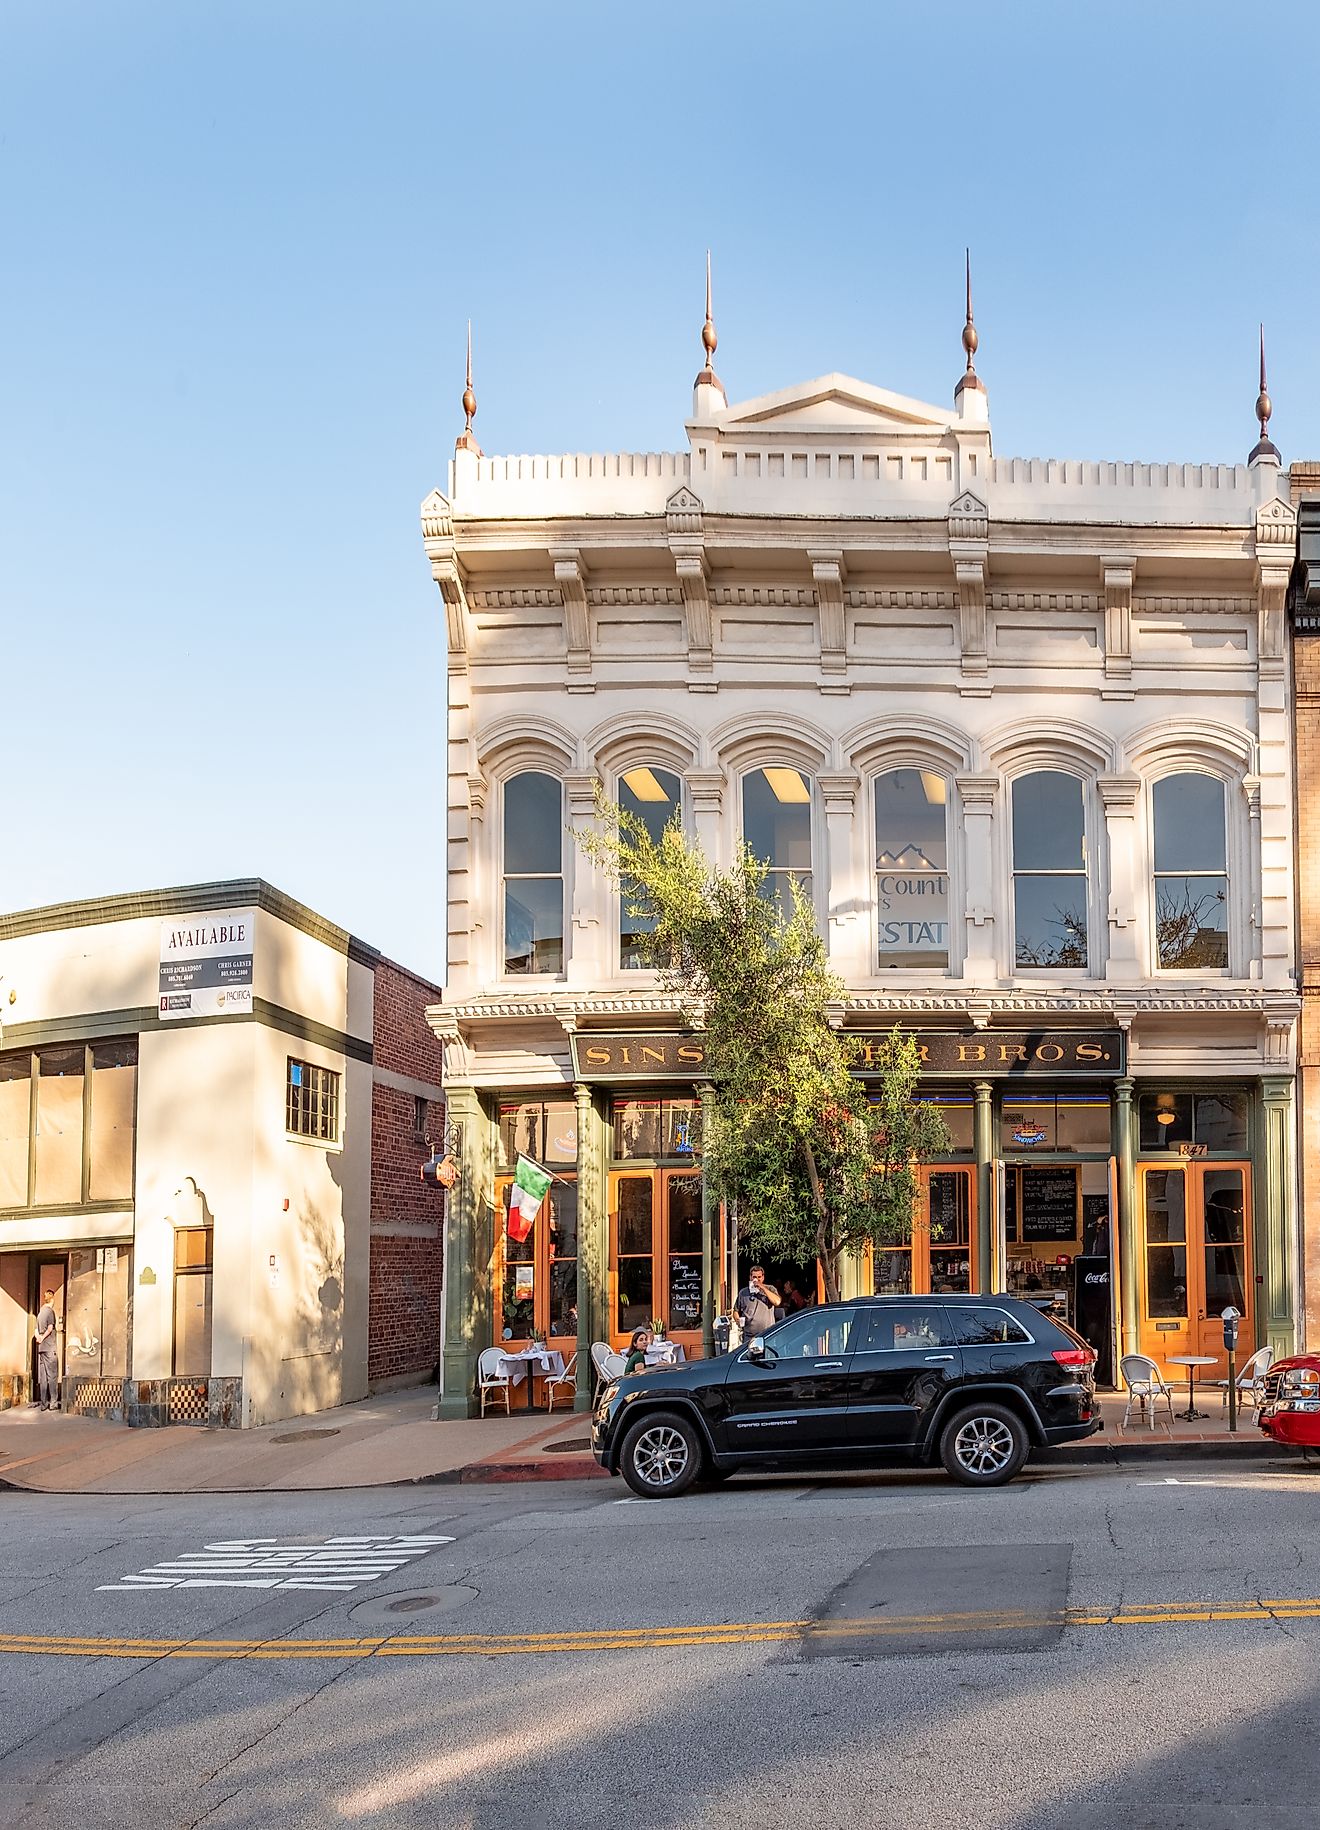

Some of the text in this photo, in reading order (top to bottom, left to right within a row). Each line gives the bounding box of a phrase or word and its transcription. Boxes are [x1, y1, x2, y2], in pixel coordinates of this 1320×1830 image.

[168, 925, 246, 949] AVAILABLE
[218, 961, 232, 969] CHRIS
[226, 990, 251, 1001] PACIFICA
[956, 1043, 1111, 1062] BROS.
[1181, 1145, 1205, 1156] 847
